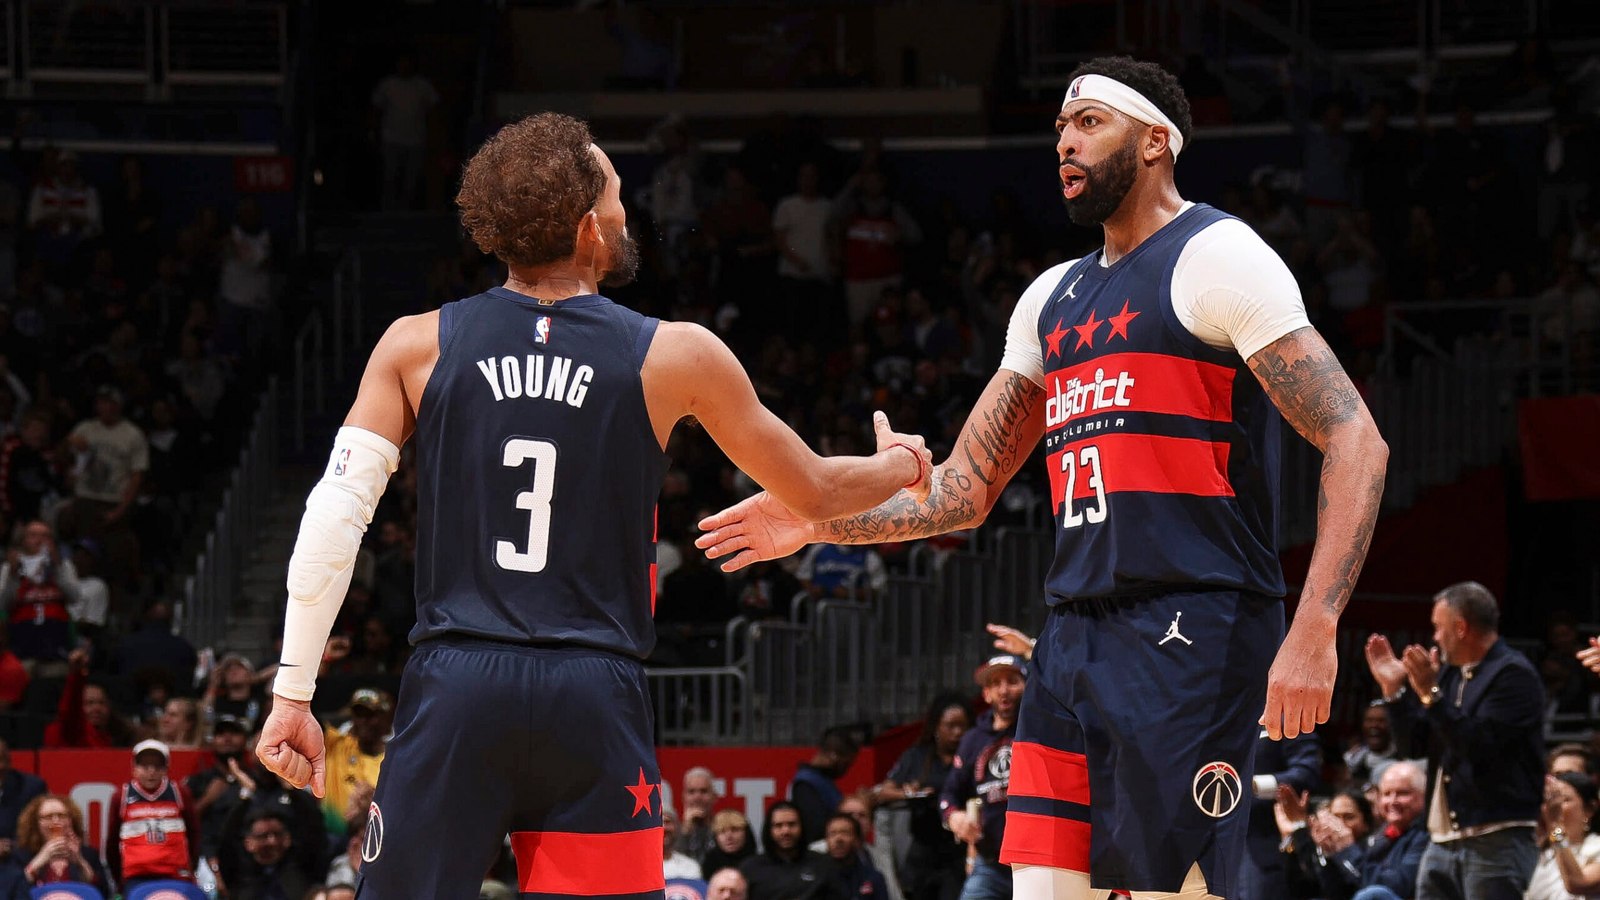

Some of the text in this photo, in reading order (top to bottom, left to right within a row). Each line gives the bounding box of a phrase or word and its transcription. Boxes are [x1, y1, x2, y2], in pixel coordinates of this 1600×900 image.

[476, 354, 594, 409] YOUNG
[1046, 435, 1060, 448] OF
[495, 437, 557, 573] 3
[1061, 445, 1107, 529] 23
